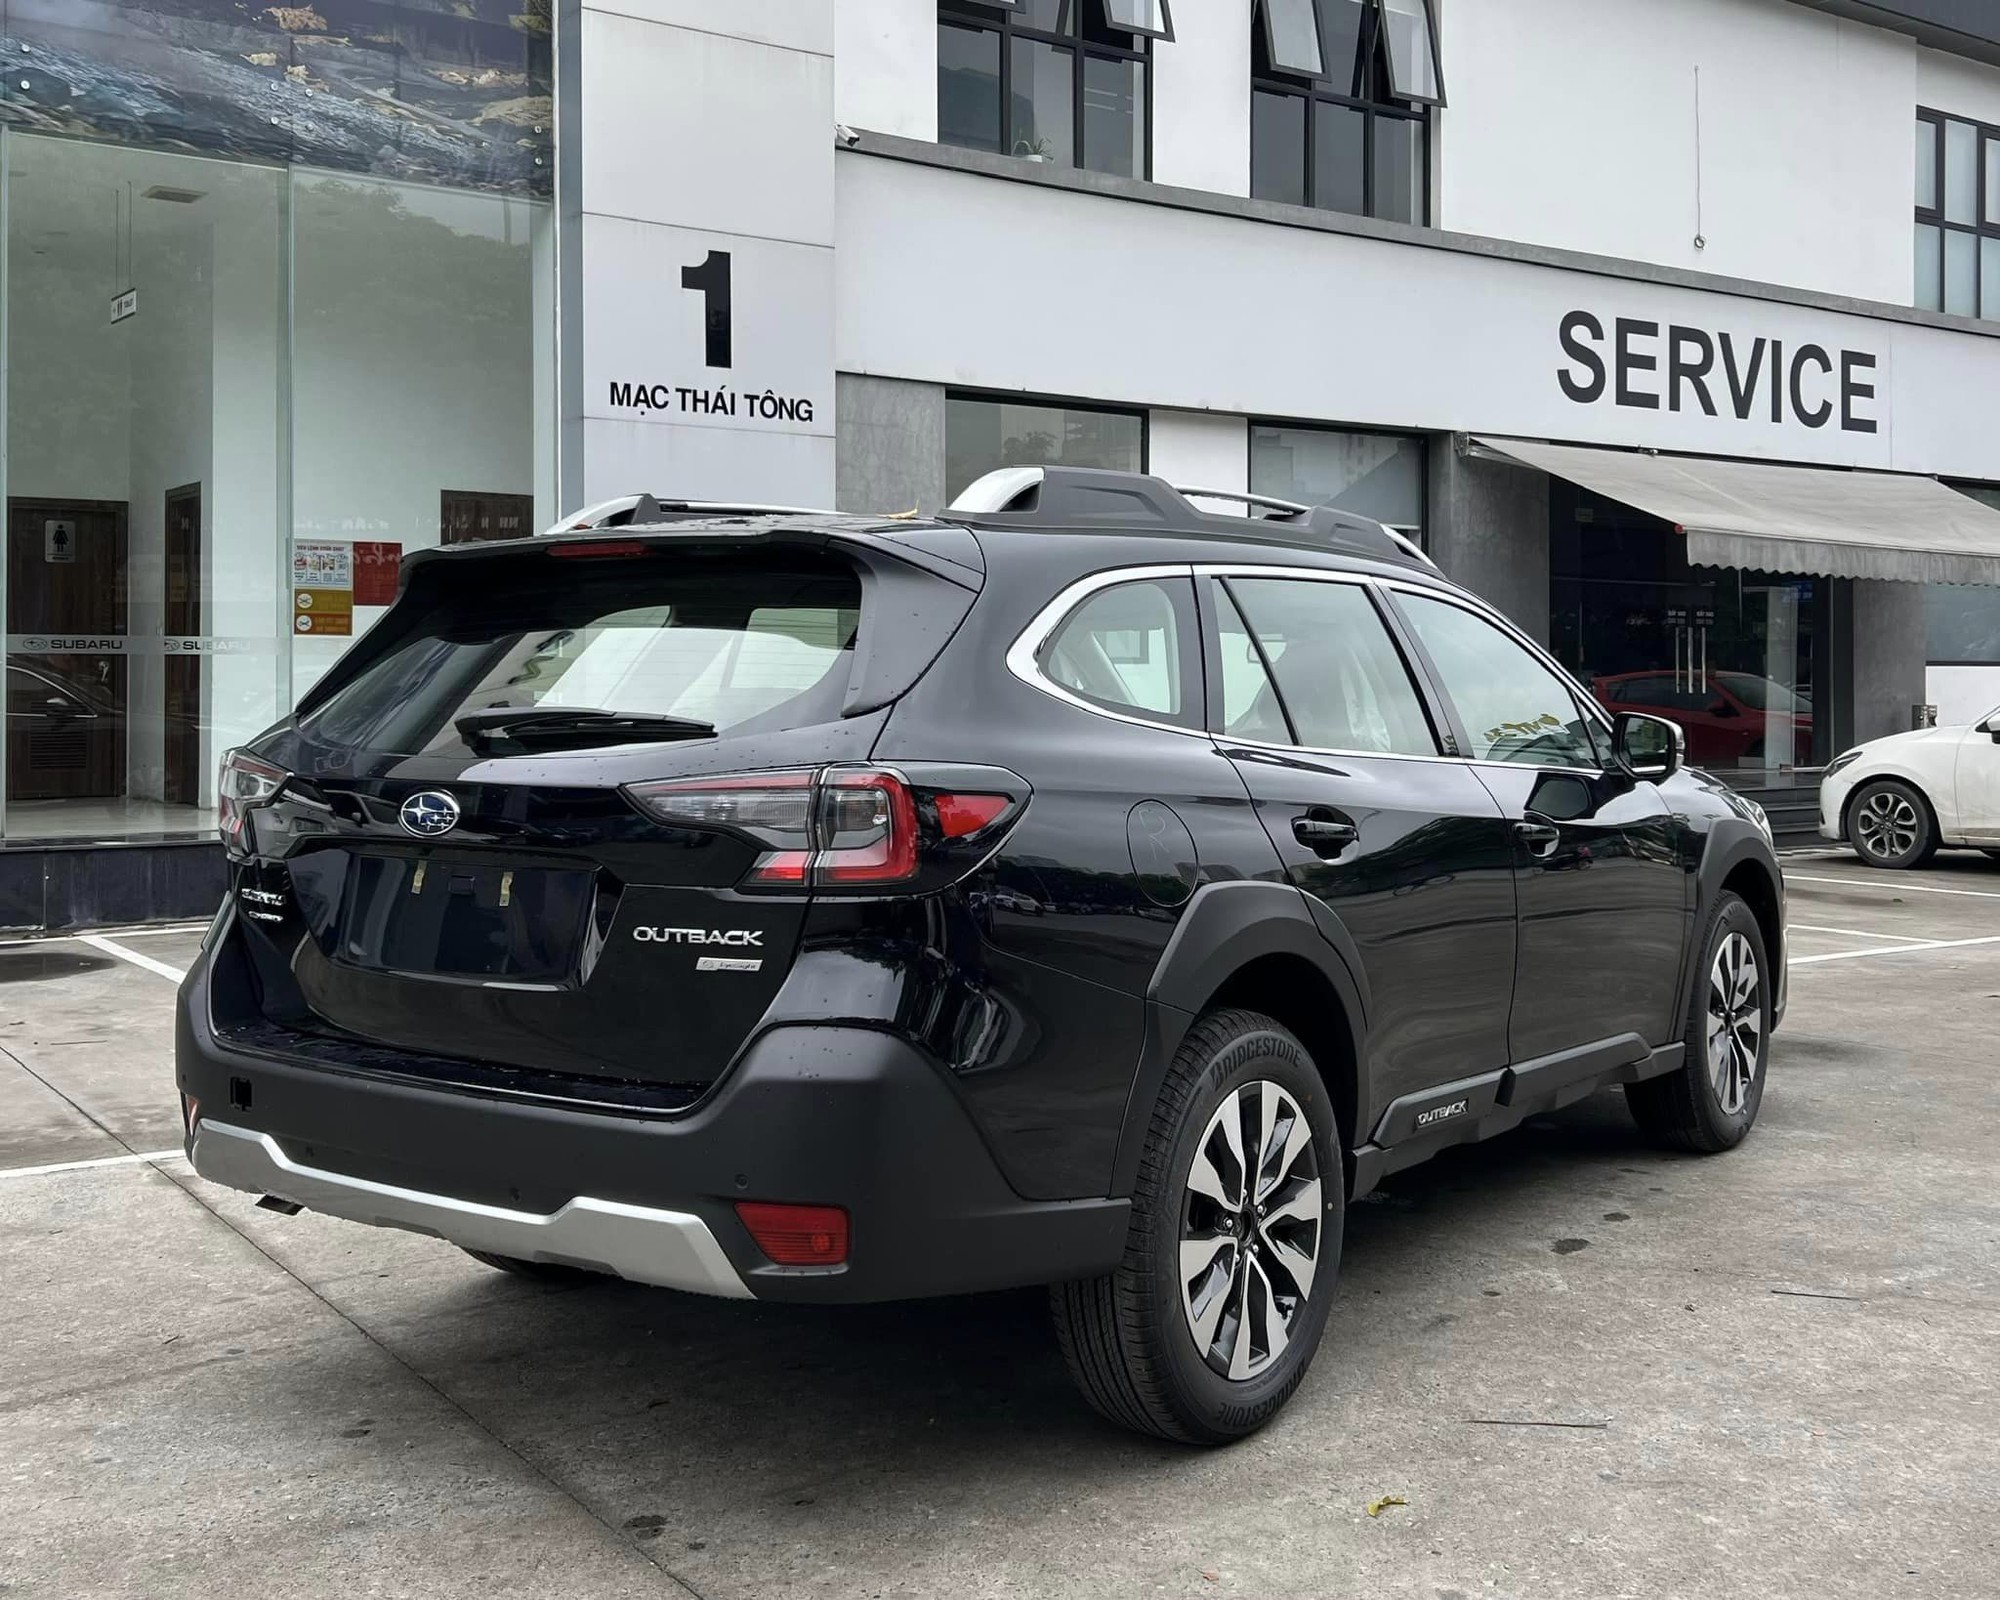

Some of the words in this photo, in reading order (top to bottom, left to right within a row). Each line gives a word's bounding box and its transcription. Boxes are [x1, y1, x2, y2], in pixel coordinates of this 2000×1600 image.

[681, 250, 732, 369] 1
[1557, 310, 1877, 434] SERVICE
[610, 382, 670, 416] MẠC
[675, 385, 736, 416] THÁI
[744, 389, 814, 422] TÔNG
[50, 639, 123, 650] SUBARU
[633, 926, 764, 946] OUTBACK
[1210, 1037, 1301, 1090] BRIDGESTONE
[1417, 1100, 1467, 1125] OUTBACK
